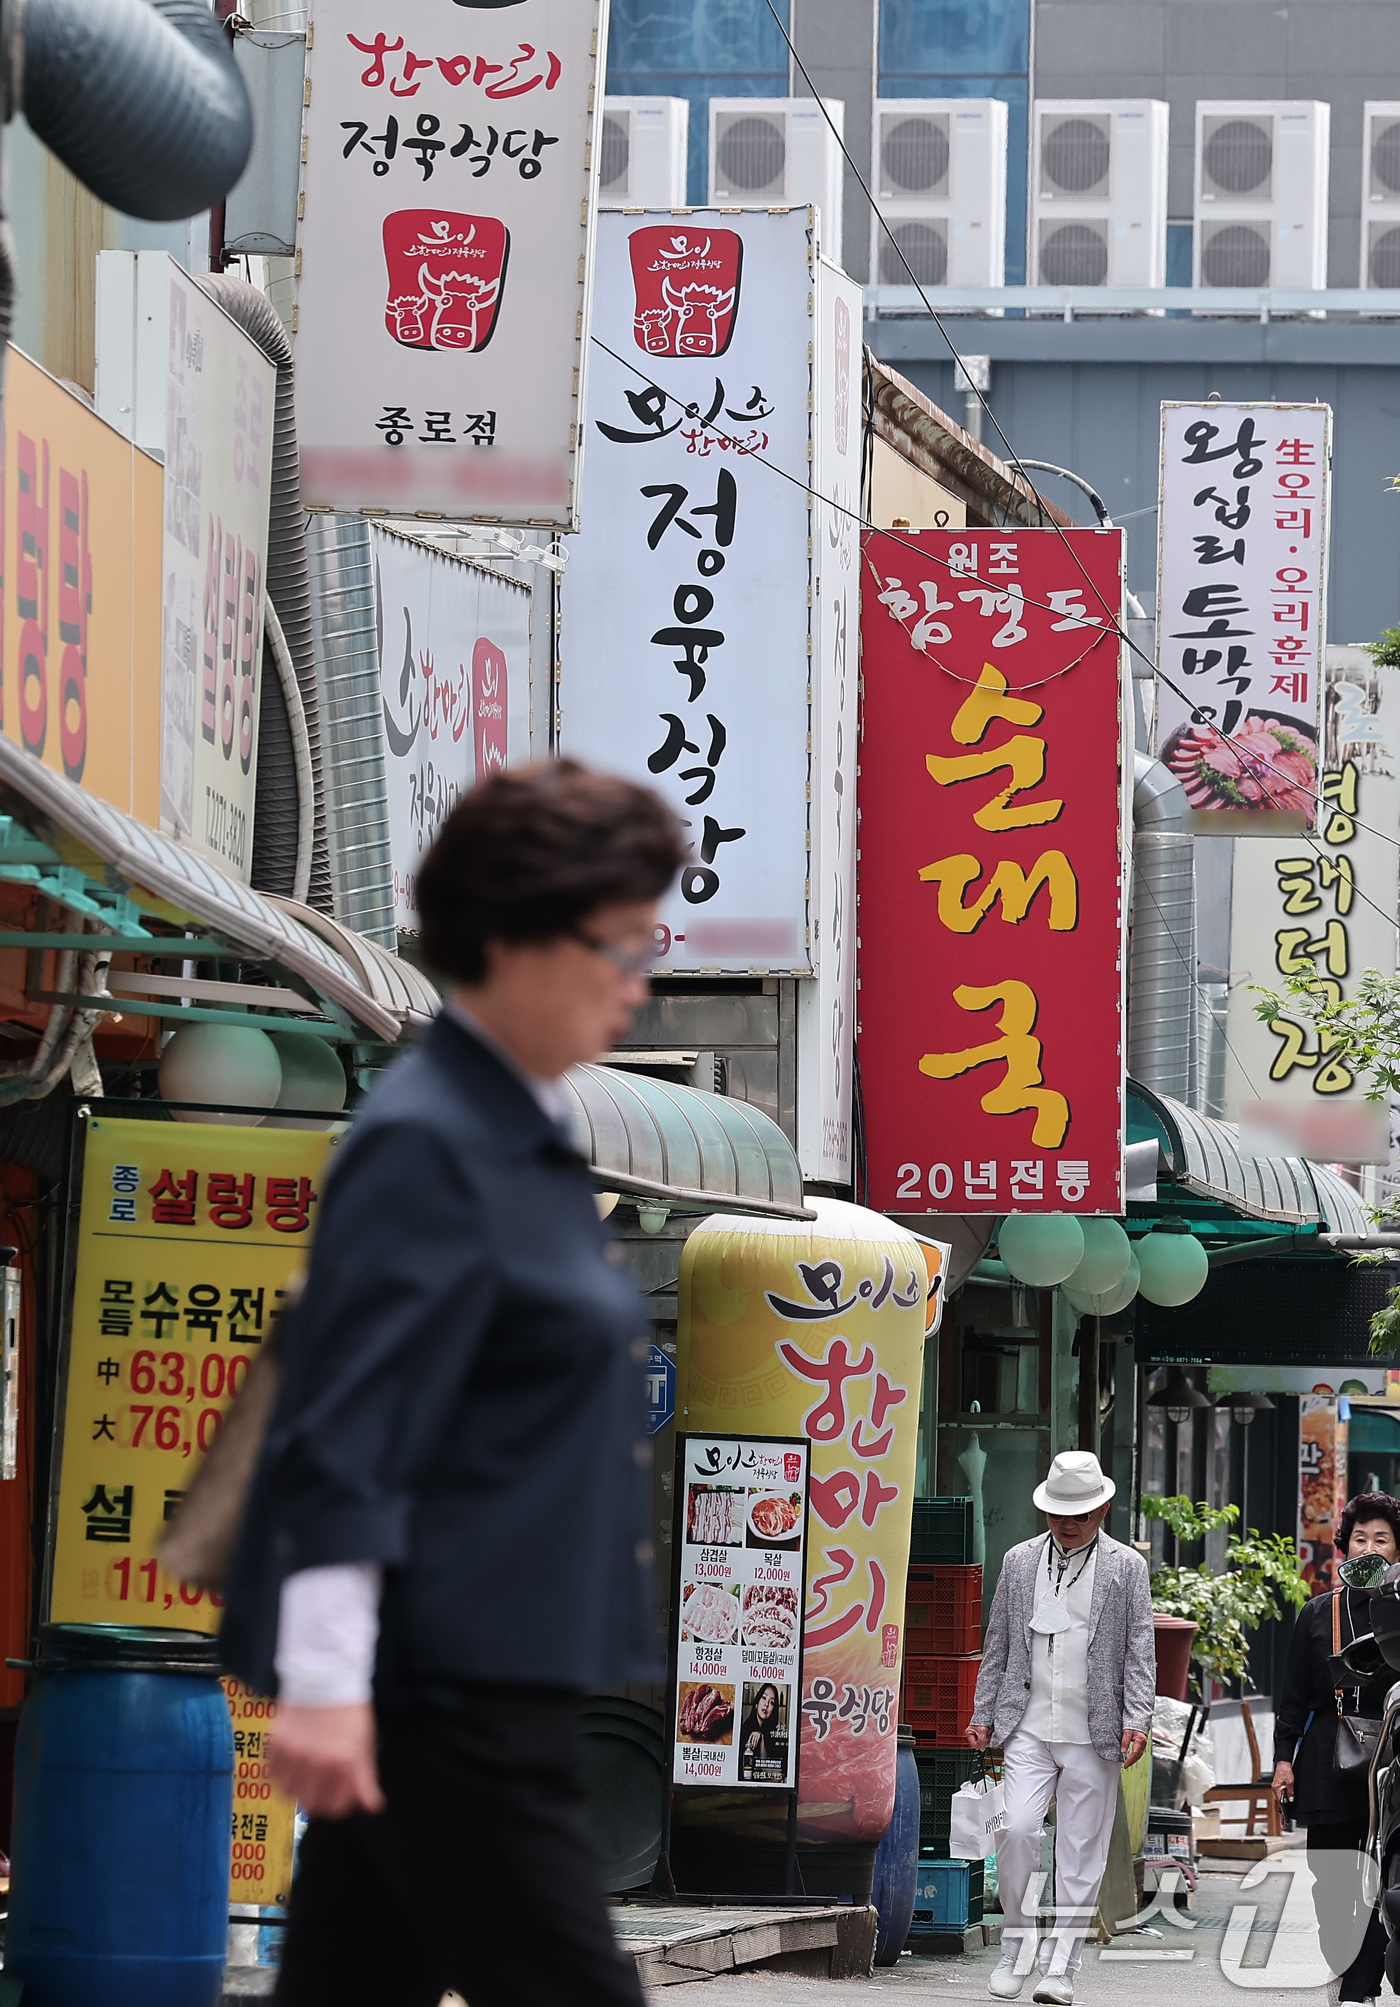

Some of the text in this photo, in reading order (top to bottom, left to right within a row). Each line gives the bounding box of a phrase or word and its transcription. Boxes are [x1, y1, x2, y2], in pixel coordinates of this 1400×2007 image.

[347, 32, 561, 99] 한마리
[340, 113, 559, 181] 정육식당
[375, 406, 497, 445] 종로점
[680, 428, 769, 457] 한마리
[1181, 417, 1266, 566] 왕십리
[948, 542, 1019, 578] 원조
[0, 430, 92, 784] 렁탕
[877, 577, 1103, 649] 함경도
[1168, 584, 1256, 738] 토박이
[639, 467, 746, 904] 정육식당
[108, 1165, 139, 1222] 종로
[896, 1159, 1090, 1201] 20년전통
[148, 1168, 317, 1232] 설렁탕
[98, 1280, 135, 1336] 모듬
[97, 1357, 119, 1385] 中
[92, 1414, 115, 1441] 大
[694, 1563, 732, 1578] 13,000원
[700, 1549, 728, 1563] 삼겹살
[754, 1567, 790, 1582] 12,000원
[764, 1553, 782, 1566] 목살
[690, 1662, 727, 1676] 14,000원
[695, 1646, 723, 1661] 항정살
[750, 1666, 785, 1680] 16,000원
[685, 1763, 722, 1777] 14,000원
